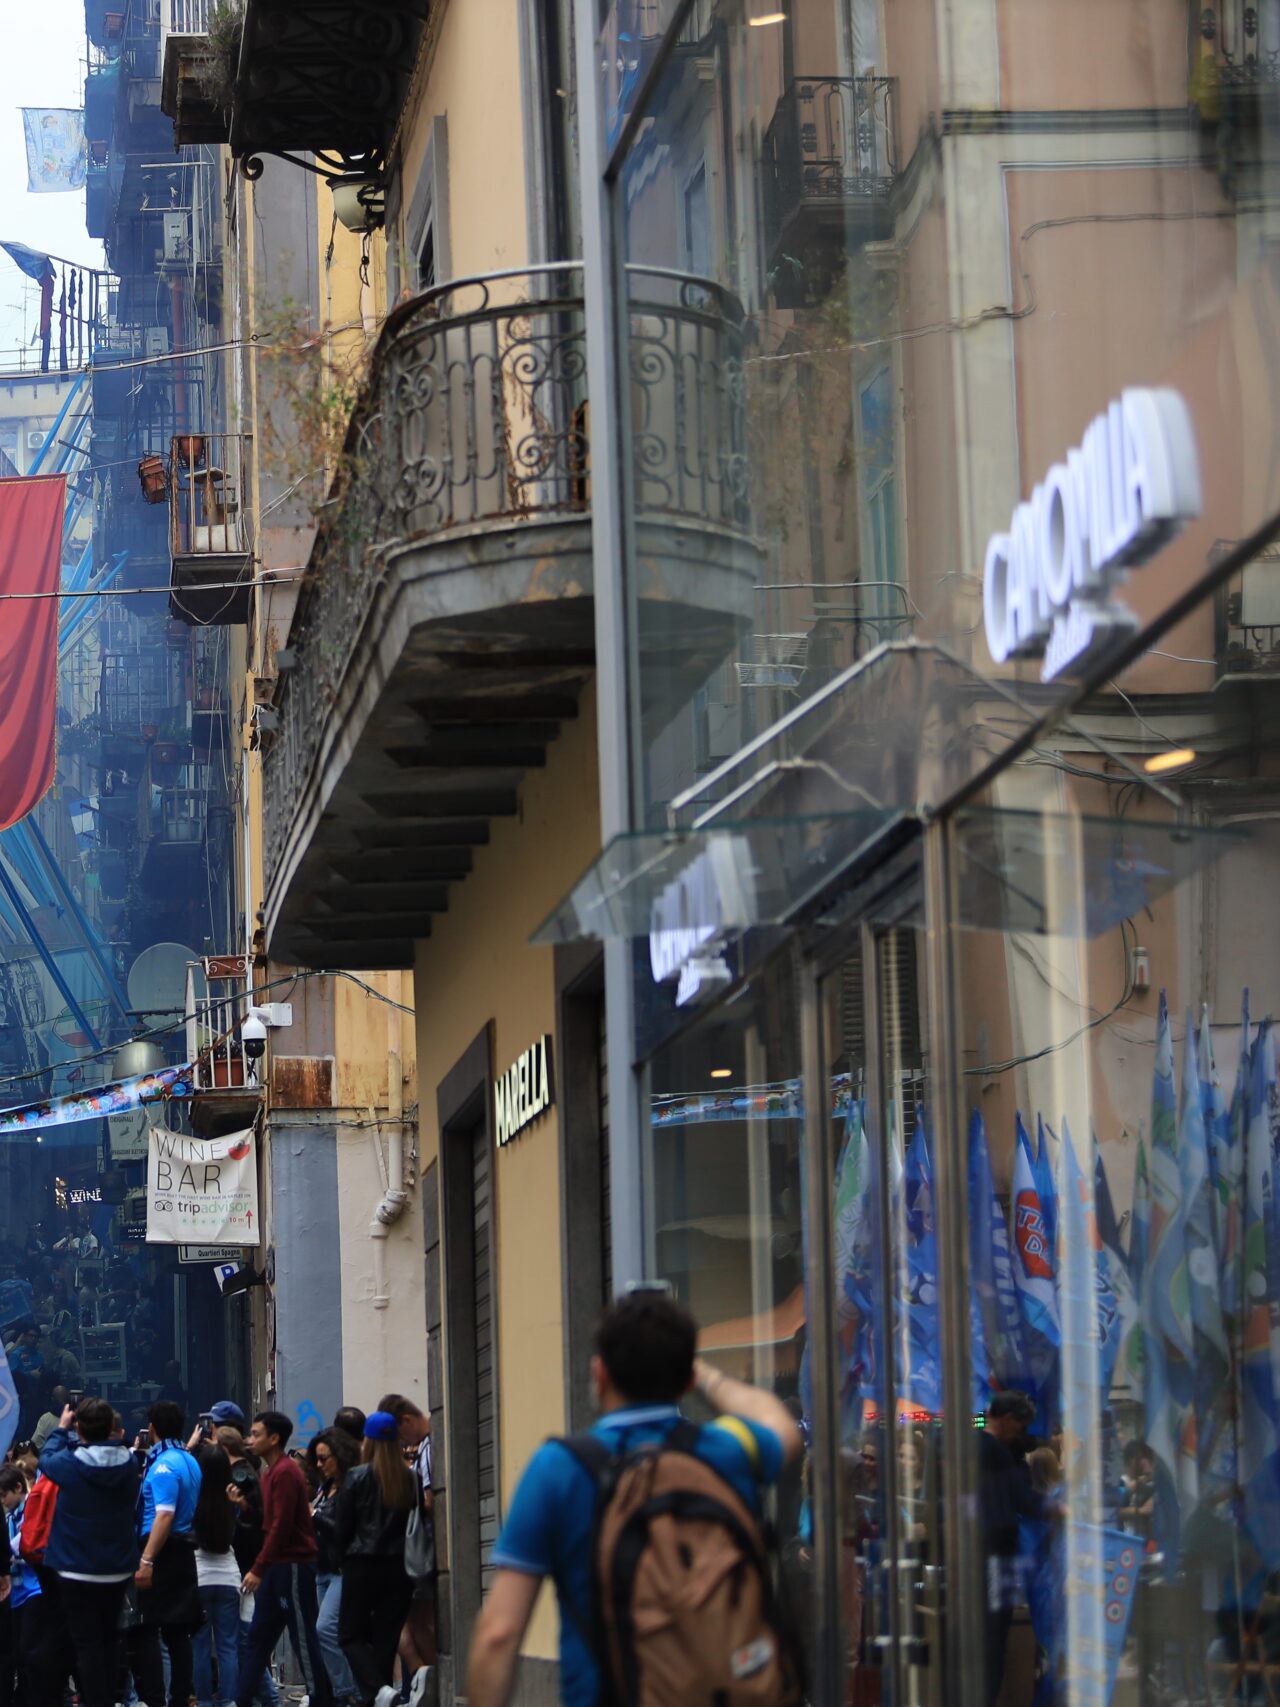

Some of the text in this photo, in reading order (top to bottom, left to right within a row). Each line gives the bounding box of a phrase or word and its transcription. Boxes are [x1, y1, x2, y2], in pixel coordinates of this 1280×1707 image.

[494, 1034, 550, 1148] MARELLA
[156, 1132, 224, 1161] WINE
[157, 1160, 221, 1194] BAR
[178, 1201, 248, 1216] tripadvisor
[197, 1248, 241, 1257] Quartieri Spagno
